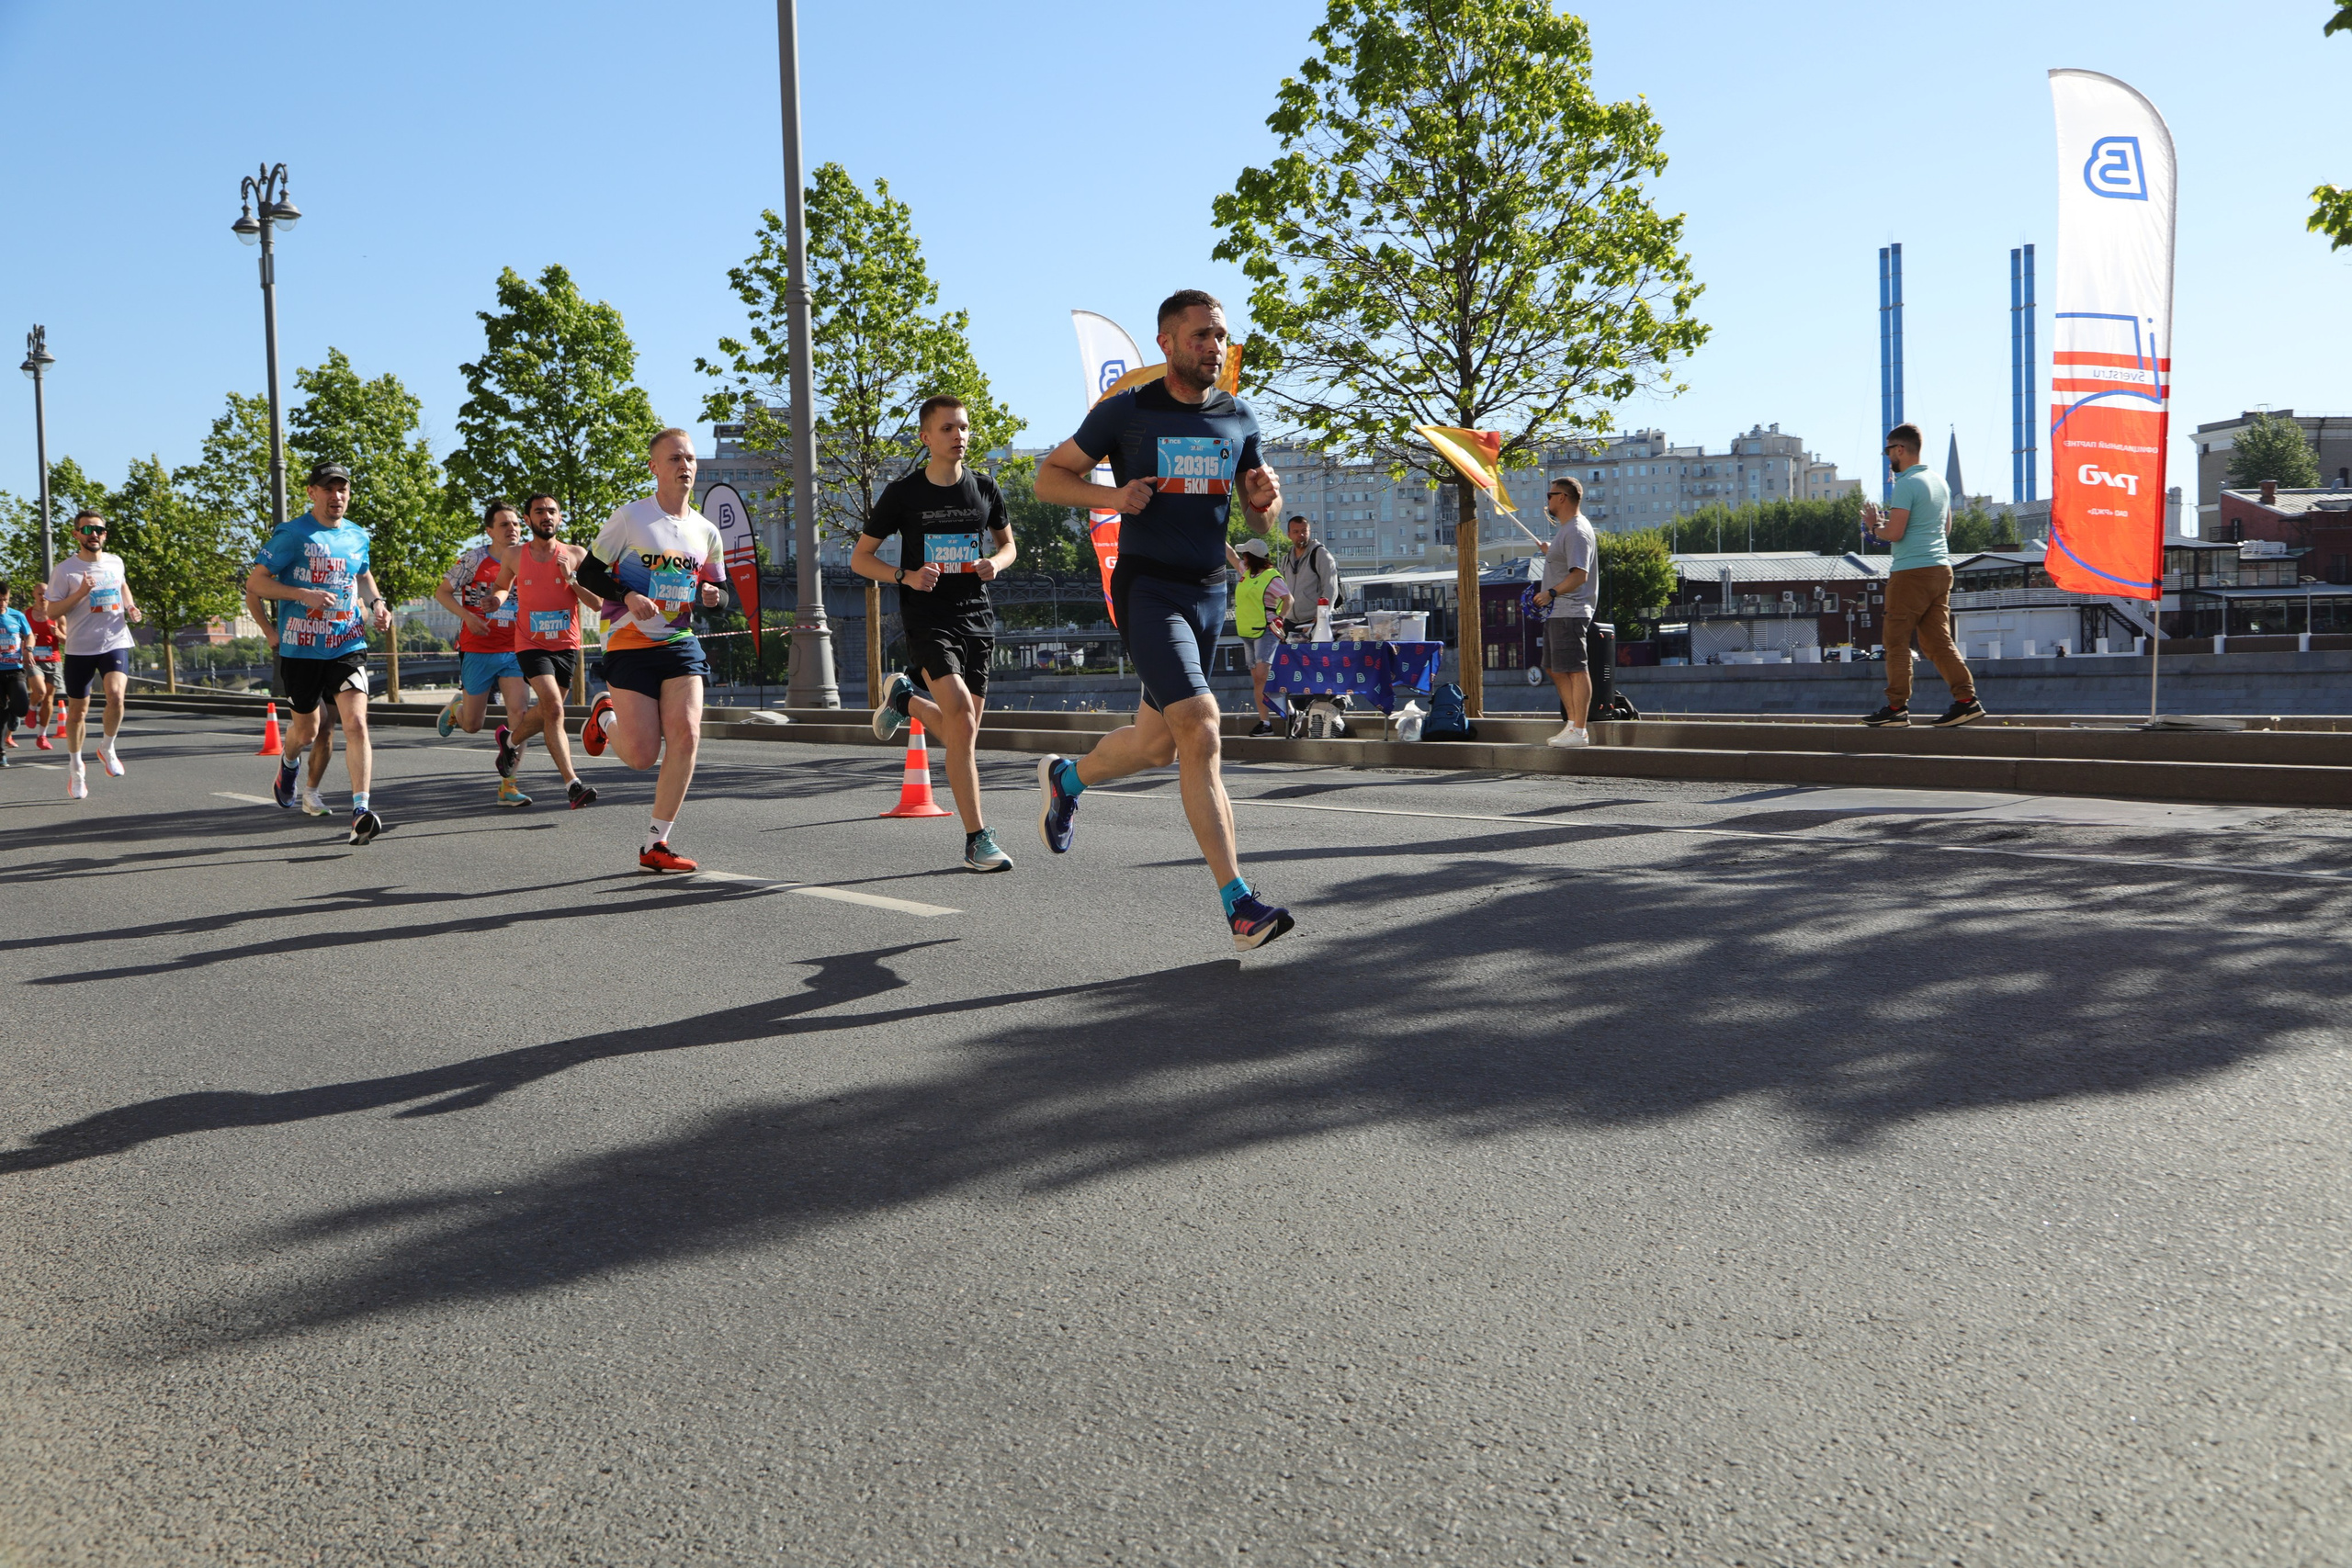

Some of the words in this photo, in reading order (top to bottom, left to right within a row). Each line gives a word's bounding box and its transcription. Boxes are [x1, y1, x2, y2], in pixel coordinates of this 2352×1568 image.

[1174, 455, 1219, 477] 20315
[1184, 478, 1209, 494] 5KM
[303, 543, 331, 557] 2024
[935, 547, 970, 561] 23047
[309, 557, 347, 571] #МЕЧТА
[944, 562, 962, 574] 5KM
[659, 583, 689, 600] 23065
[664, 600, 681, 612] 5KM
[322, 609, 337, 620] 5KM
[286, 616, 333, 635] #ЛЮБОВЬ
[538, 619, 563, 631] 26771
[282, 629, 316, 647] #ЗАБЕГ
[545, 630, 559, 640] 5KM
